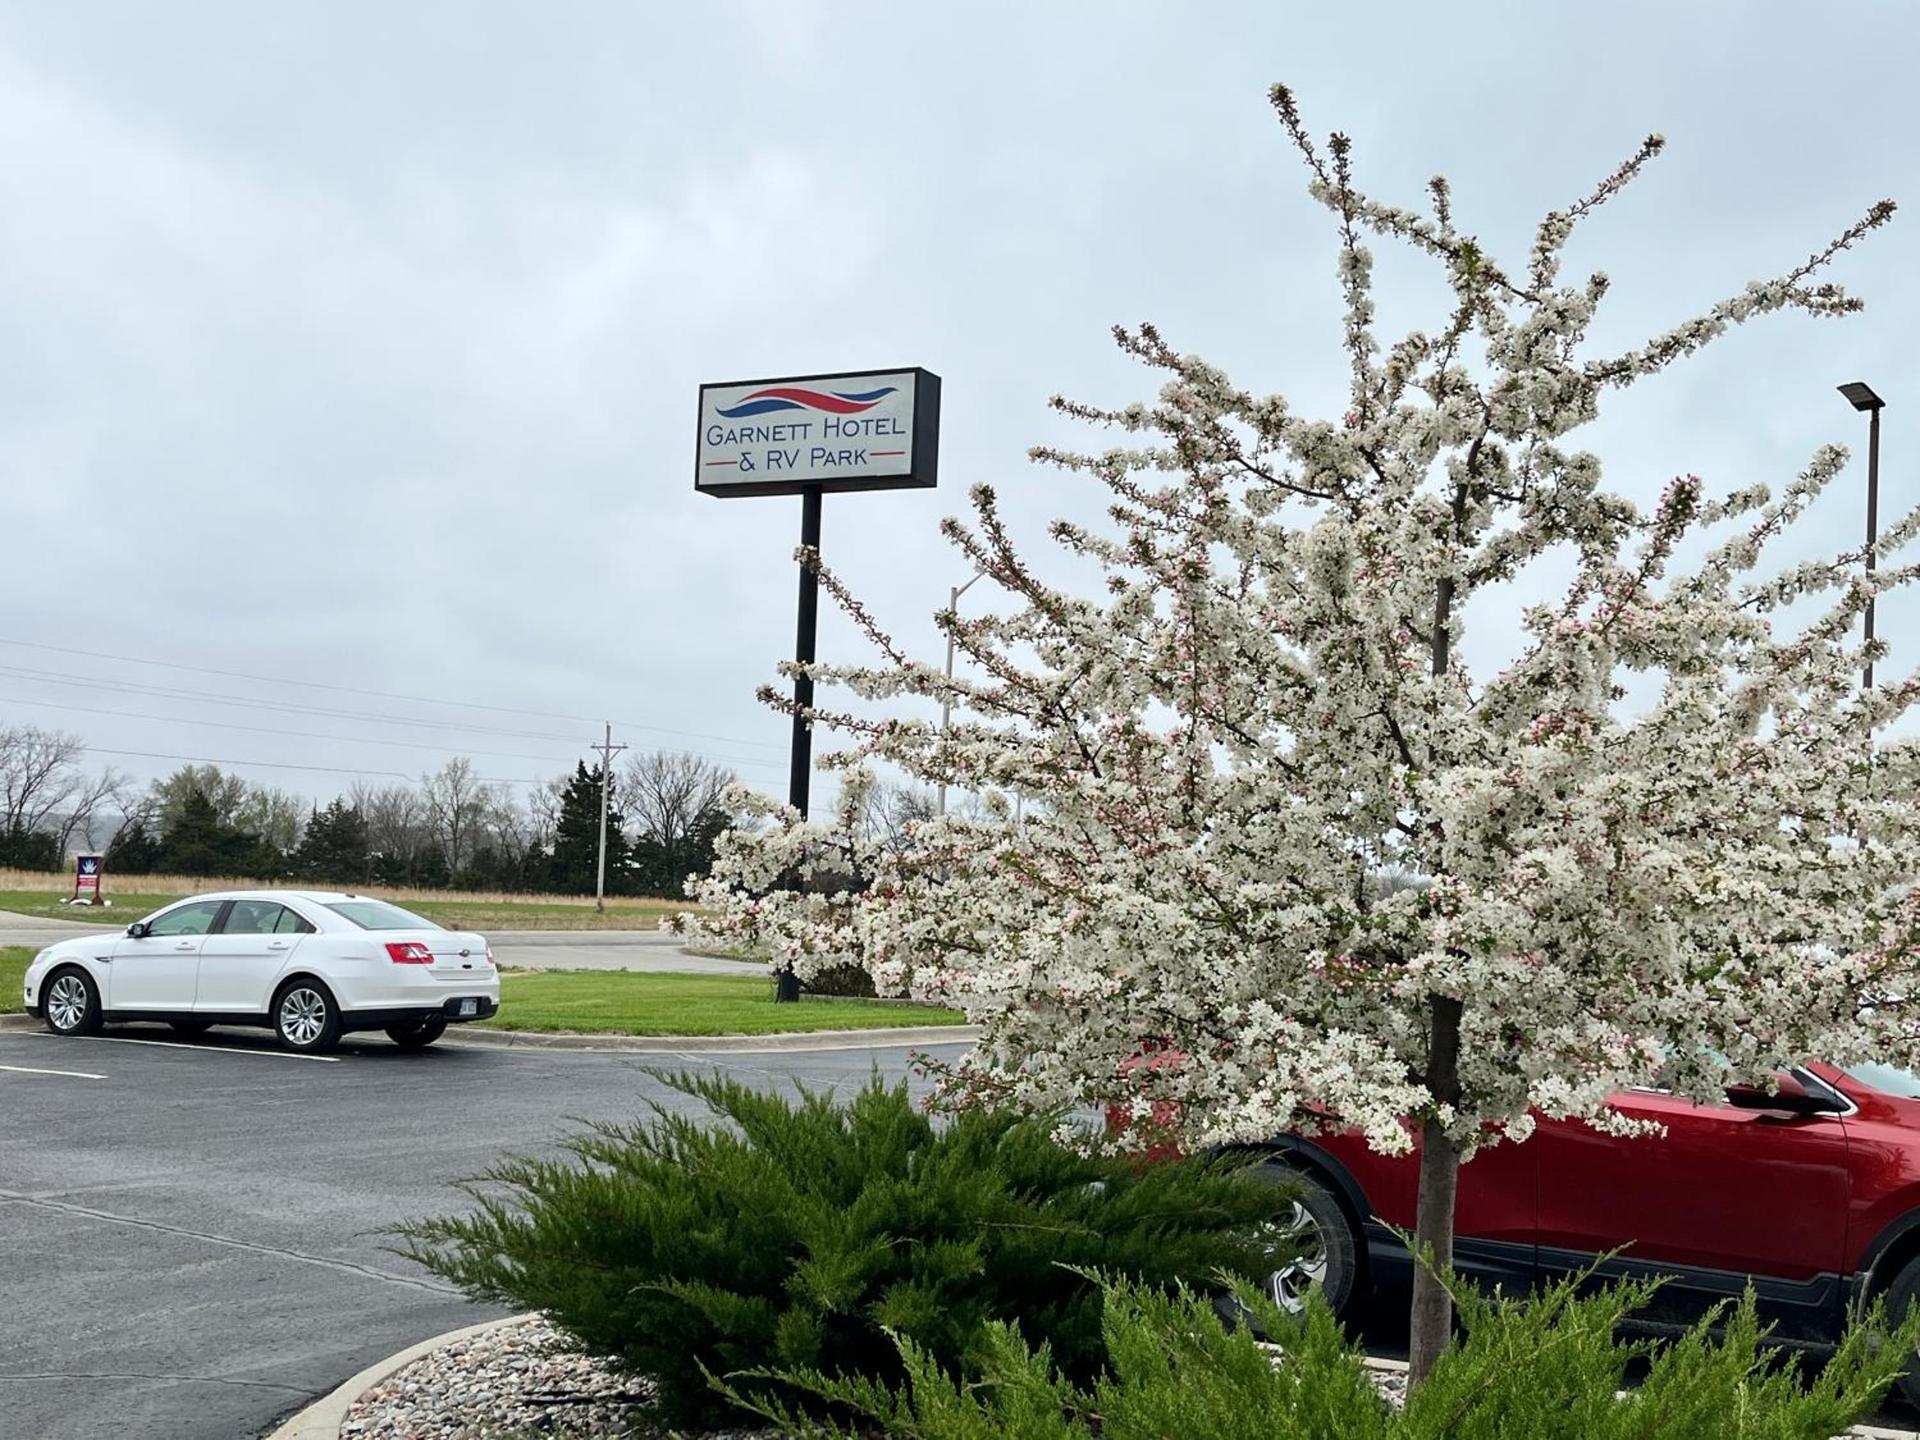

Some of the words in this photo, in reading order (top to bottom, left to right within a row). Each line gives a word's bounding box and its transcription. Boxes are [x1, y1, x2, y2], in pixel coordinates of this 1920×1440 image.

[707, 423, 813, 446] GARNETT
[823, 416, 906, 438] HOTEL
[739, 452, 755, 471] &
[767, 449, 800, 470] RV
[810, 447, 867, 467] PARK
